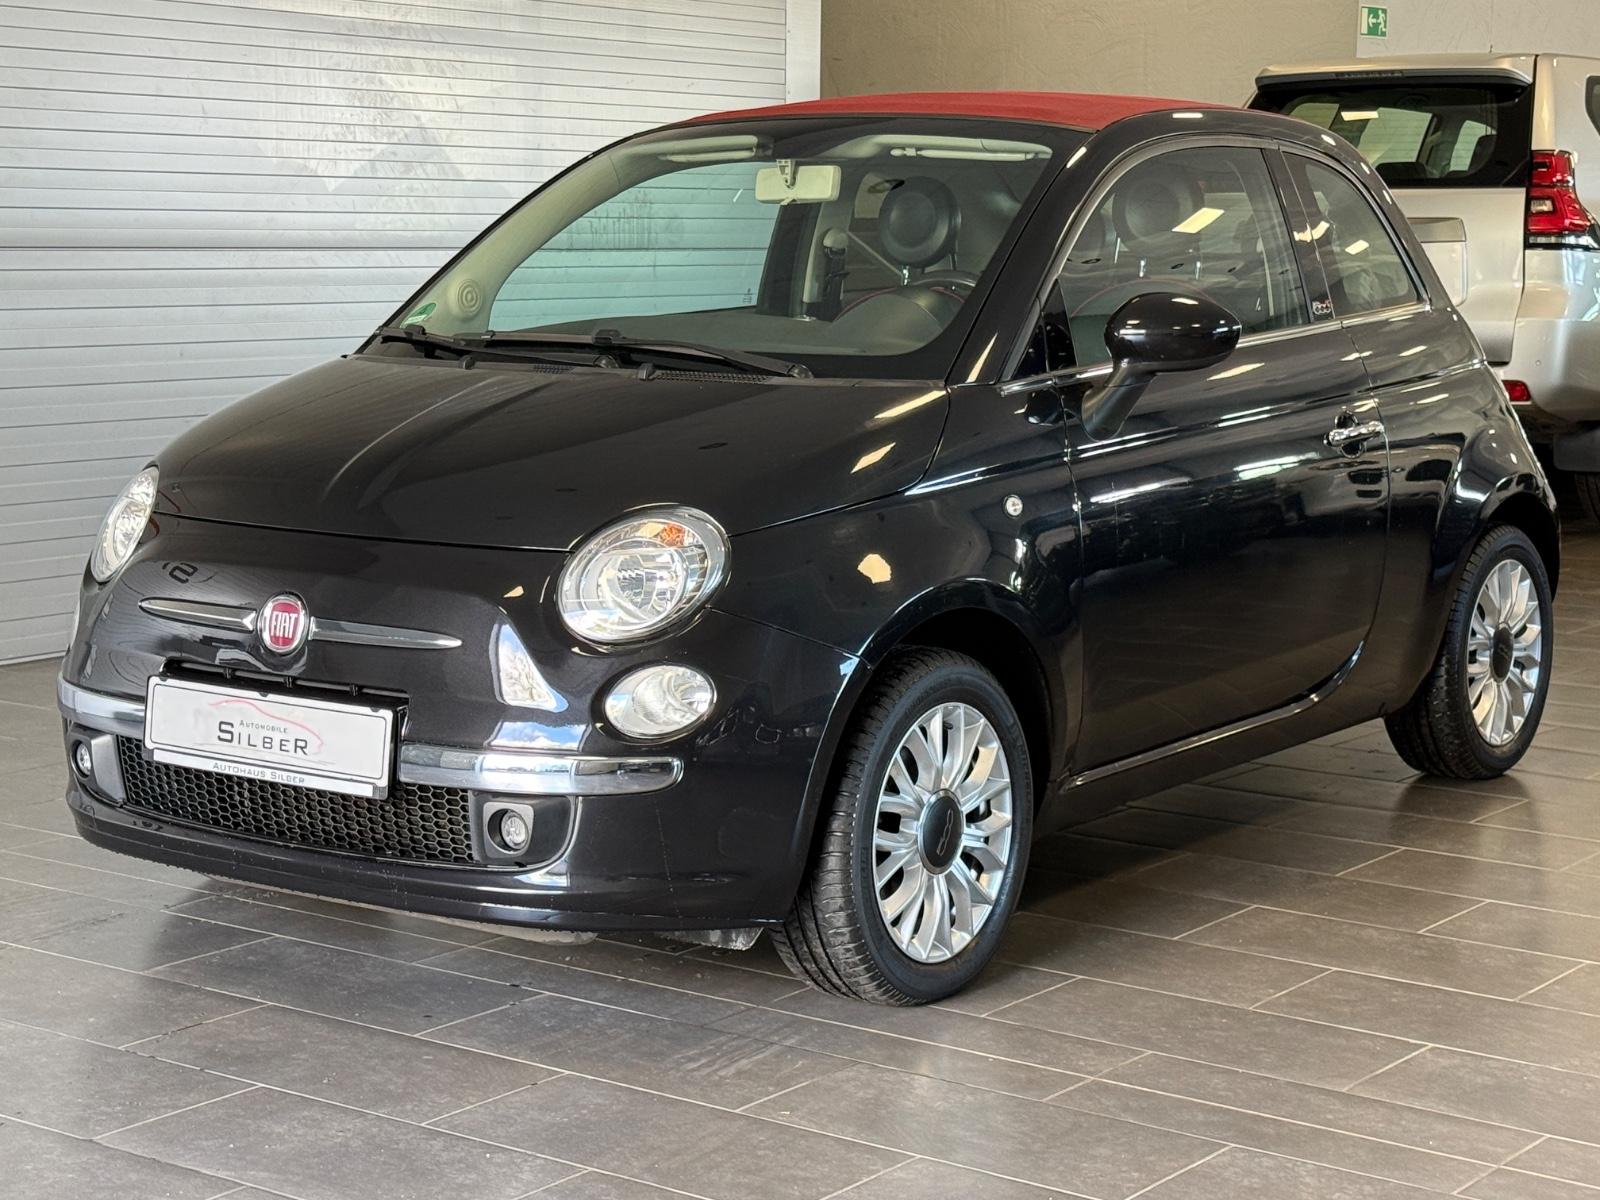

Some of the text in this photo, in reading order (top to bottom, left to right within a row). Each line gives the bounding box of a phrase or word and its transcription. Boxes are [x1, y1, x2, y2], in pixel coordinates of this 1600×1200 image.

[270, 611, 298, 639] FIAT
[217, 720, 308, 756] SILBER
[239, 719, 288, 733] AUTOMOBILE
[212, 762, 305, 785] AUTOHAUS SILBER
